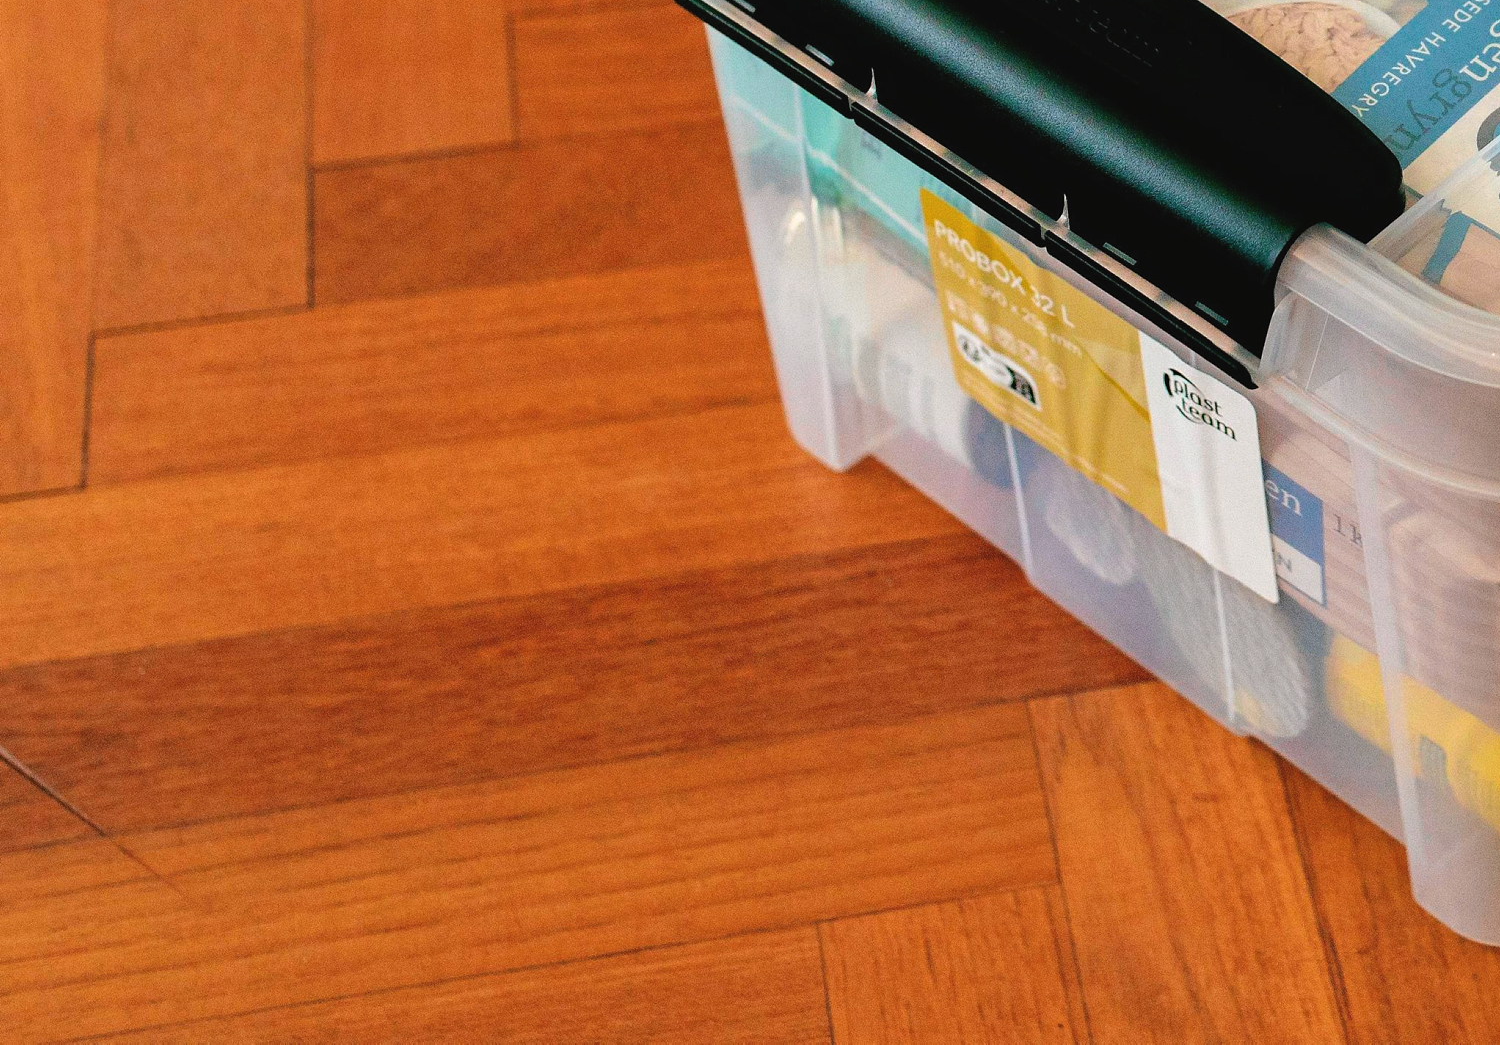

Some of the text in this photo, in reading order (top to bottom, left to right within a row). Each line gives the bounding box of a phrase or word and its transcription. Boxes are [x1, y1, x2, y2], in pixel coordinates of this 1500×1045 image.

[1351, 31, 1447, 117] HAVREGRY
[934, 219, 1026, 296] PROBOX
[1030, 284, 1057, 317] 32
[1061, 304, 1076, 329] L
[1173, 379, 1223, 417] plast
[1181, 397, 1237, 441] team
